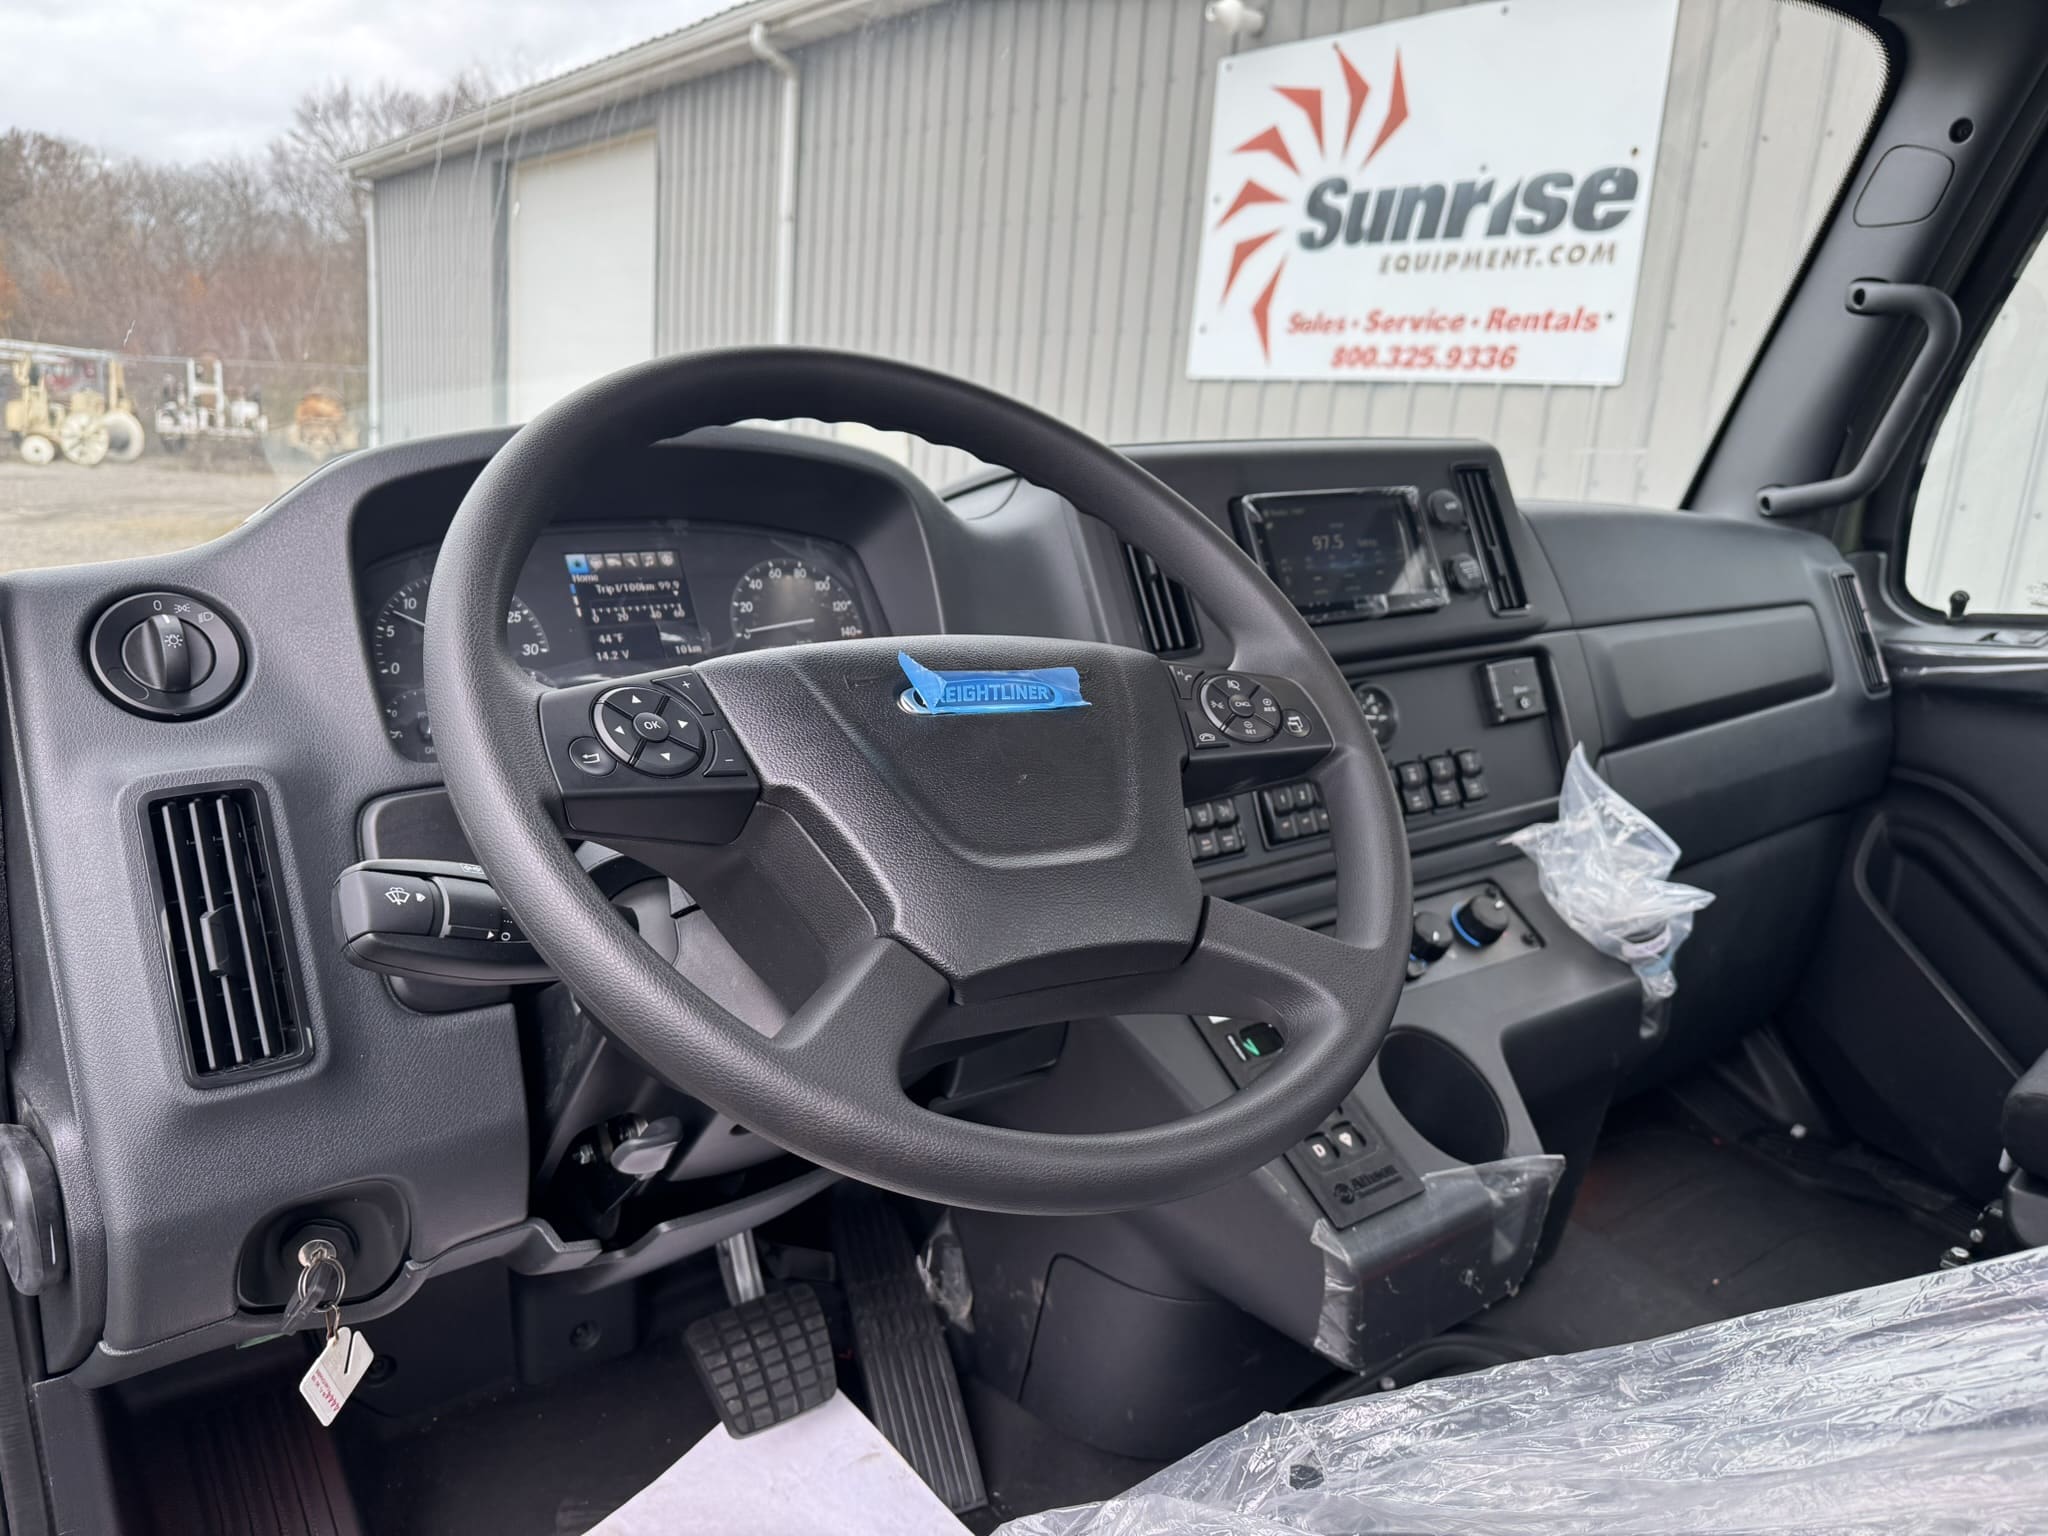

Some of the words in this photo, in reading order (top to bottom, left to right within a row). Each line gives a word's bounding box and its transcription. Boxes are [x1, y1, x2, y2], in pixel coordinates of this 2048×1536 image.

[1298, 167, 1640, 250] Sunrise
[1378, 242, 1617, 275] EQUIPMENT.COM
[1286, 312, 1346, 335] Sales
[1363, 309, 1466, 334] Service
[1485, 306, 1600, 333] Rentals
[1330, 346, 1518, 370] 800.325.9336
[1311, 534, 1345, 551] 97.5
[769, 569, 782, 578] 60
[794, 569, 807, 578] 80
[749, 579, 763, 590] 40
[815, 580, 830, 591] 100
[404, 598, 417, 609] 10
[740, 602, 753, 613] 20
[832, 602, 848, 612] 120
[507, 611, 521, 623] 25
[386, 625, 395, 637] 5
[841, 627, 857, 637] 140
[522, 643, 539, 656] 30
[391, 663, 400, 675] 0
[643, 720, 661, 731] OK
